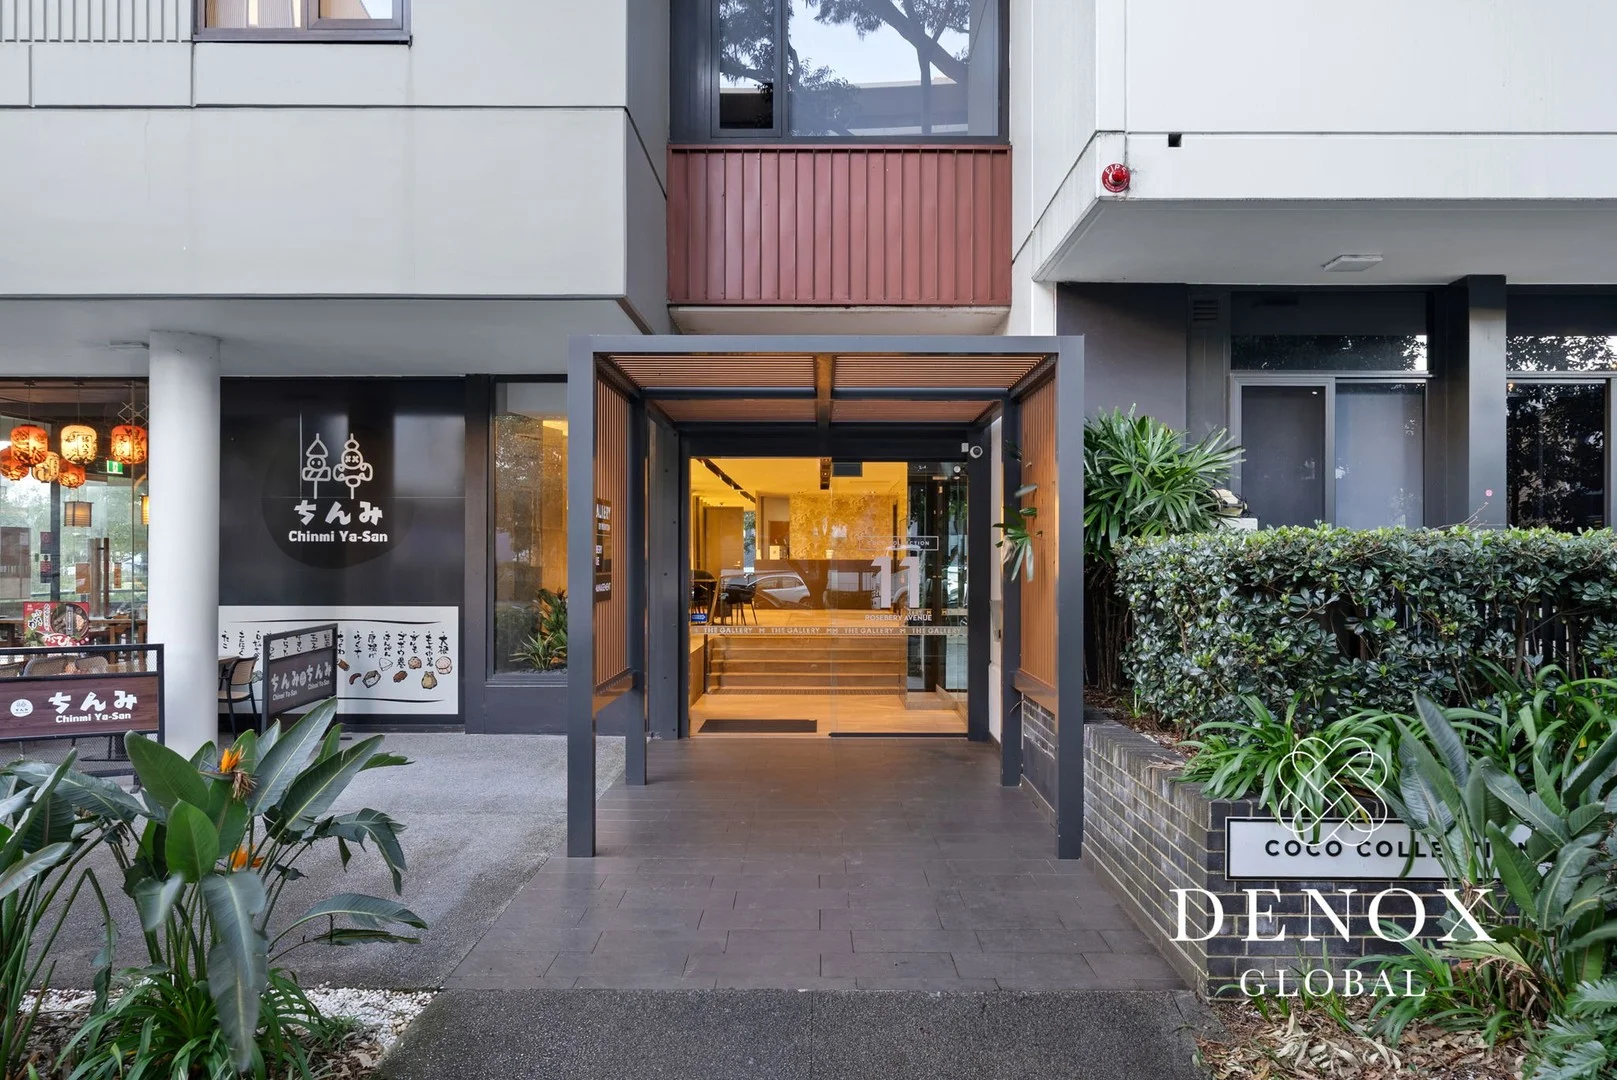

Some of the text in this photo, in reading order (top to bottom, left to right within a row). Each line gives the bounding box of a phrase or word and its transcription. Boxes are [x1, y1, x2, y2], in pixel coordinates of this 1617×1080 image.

[293, 500, 383, 526] ちんみ
[288, 530, 388, 542] Chinmi Ya-San
[871, 556, 920, 608] 11
[439, 634, 449, 654] 大根
[48, 690, 138, 714] ちんみ
[56, 711, 131, 723] Chinmi Ya-San
[1265, 839, 1342, 858] COCO
